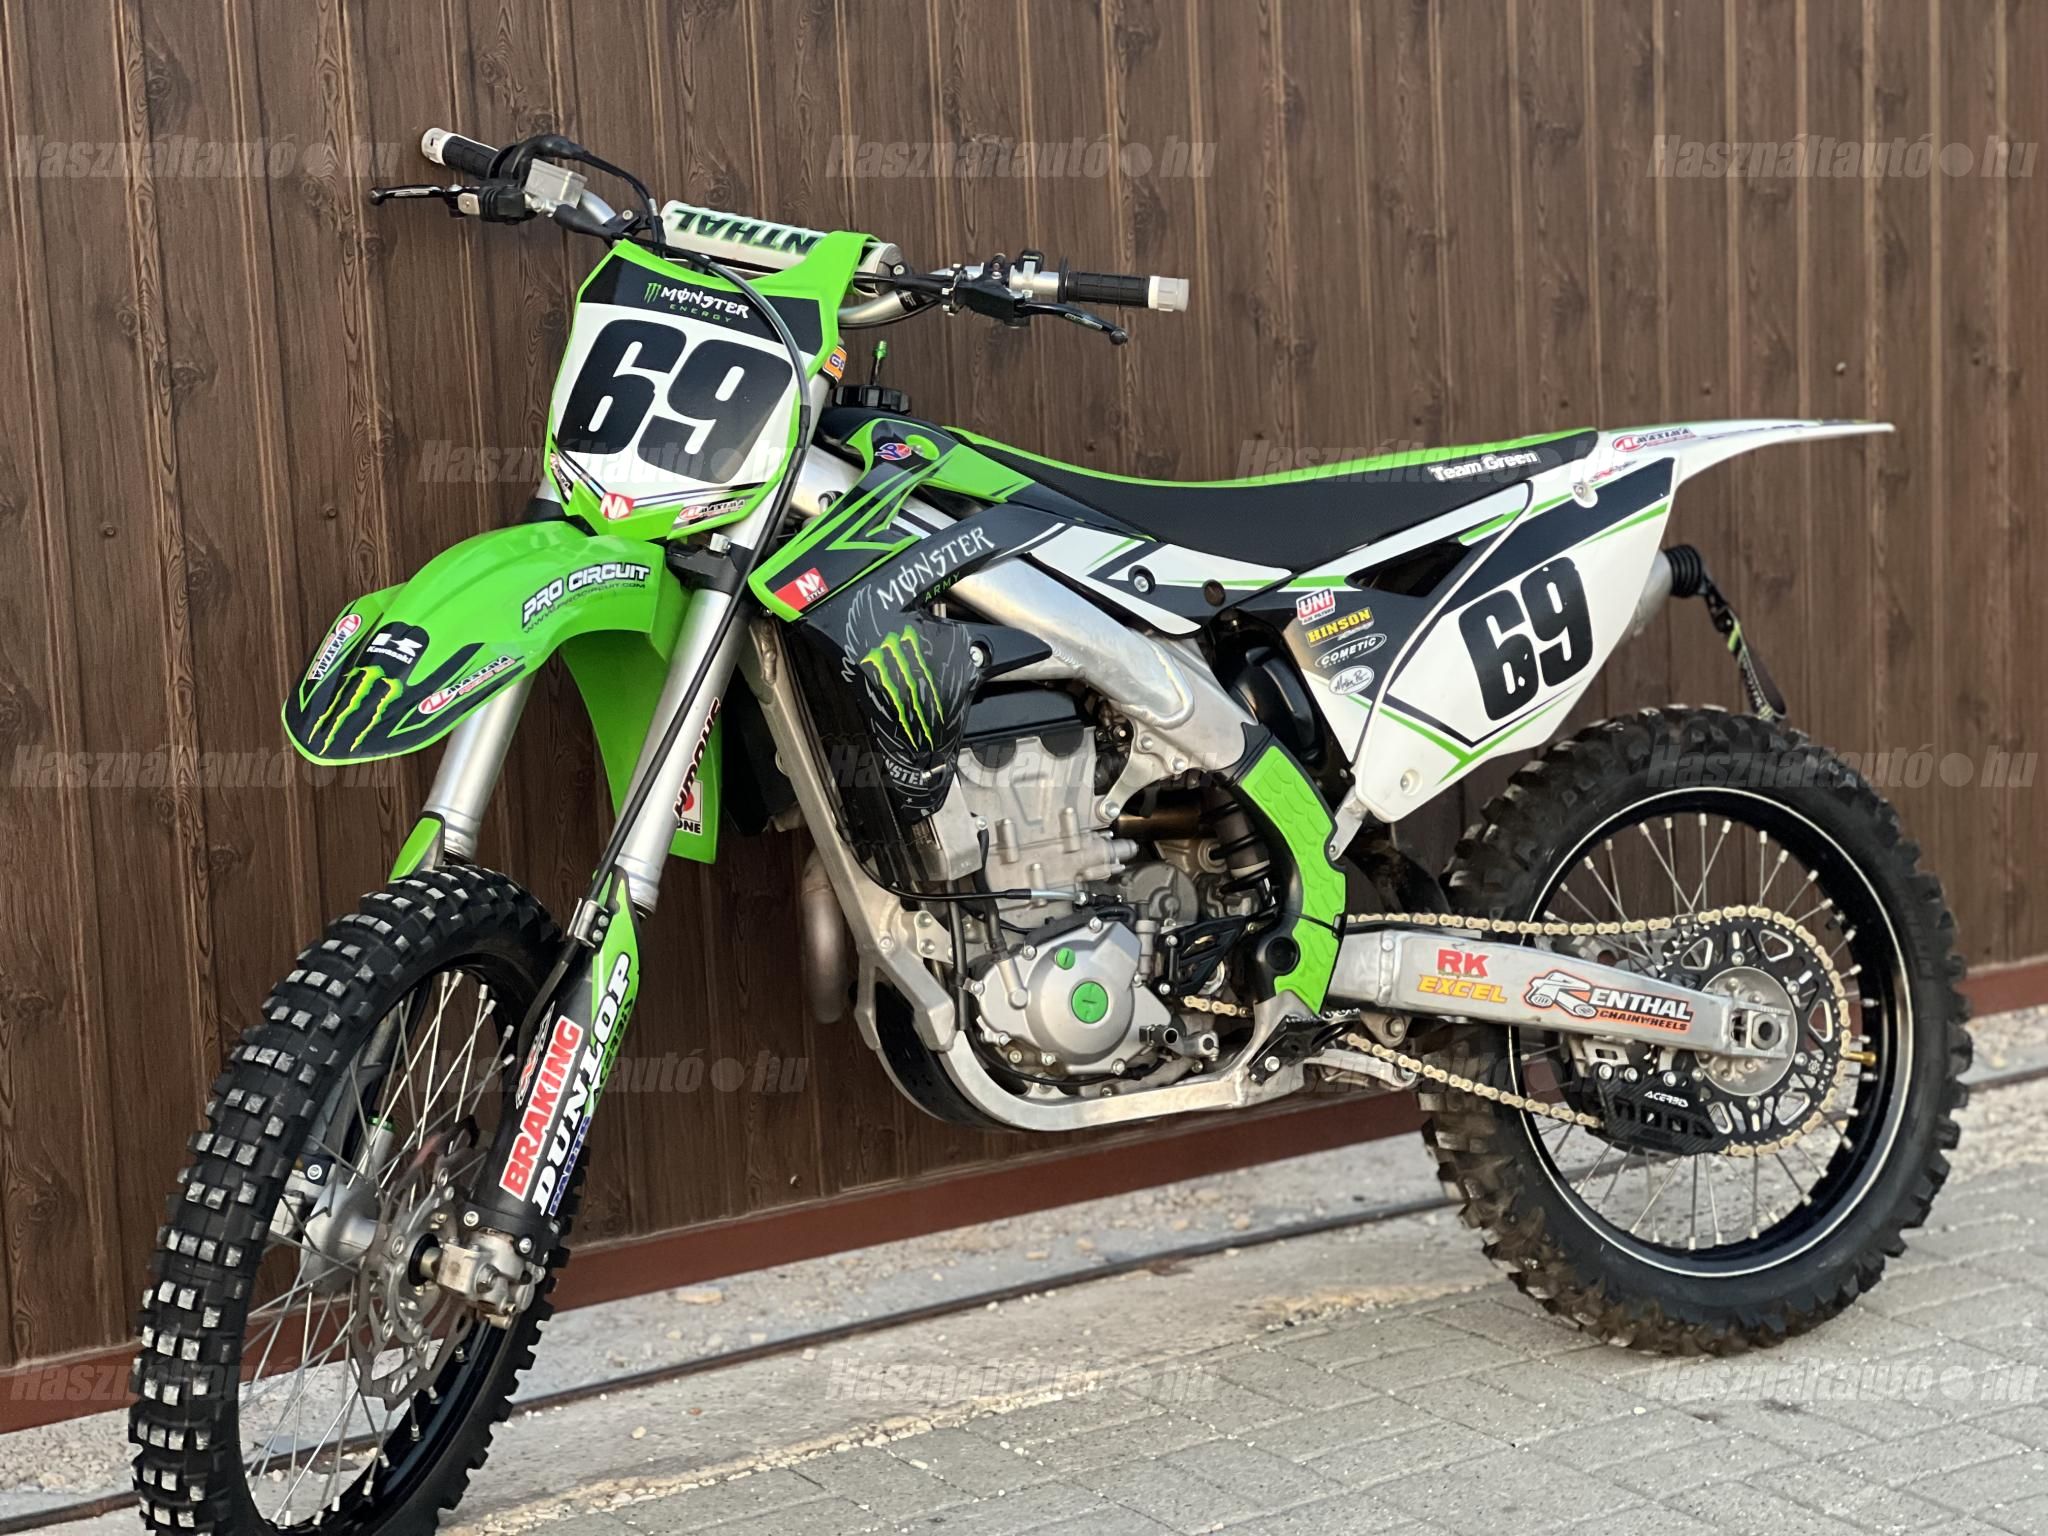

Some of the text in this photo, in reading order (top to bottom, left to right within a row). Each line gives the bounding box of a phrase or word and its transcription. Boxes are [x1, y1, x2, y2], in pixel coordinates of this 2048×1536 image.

[673, 209, 823, 255] NTHAL
[669, 303, 732, 323] ENERGY
[557, 319, 794, 485] 69
[1427, 451, 1538, 482] Team Green
[523, 562, 650, 628] PRO CIRCUIT
[925, 572, 960, 602] ARMY
[1299, 589, 1333, 615] UNI
[1307, 609, 1371, 642] HINSON
[1458, 557, 1594, 722] 69
[366, 645, 413, 665] Kawasaki
[1321, 638, 1377, 665] COMETIC
[1437, 948, 1488, 978] RK
[1417, 974, 1508, 1004] EXCEL
[1600, 1009, 1689, 1031] CHAINWHEELS
[532, 952, 631, 1217] DUNLOP
[501, 1017, 582, 1200] BRAKING
